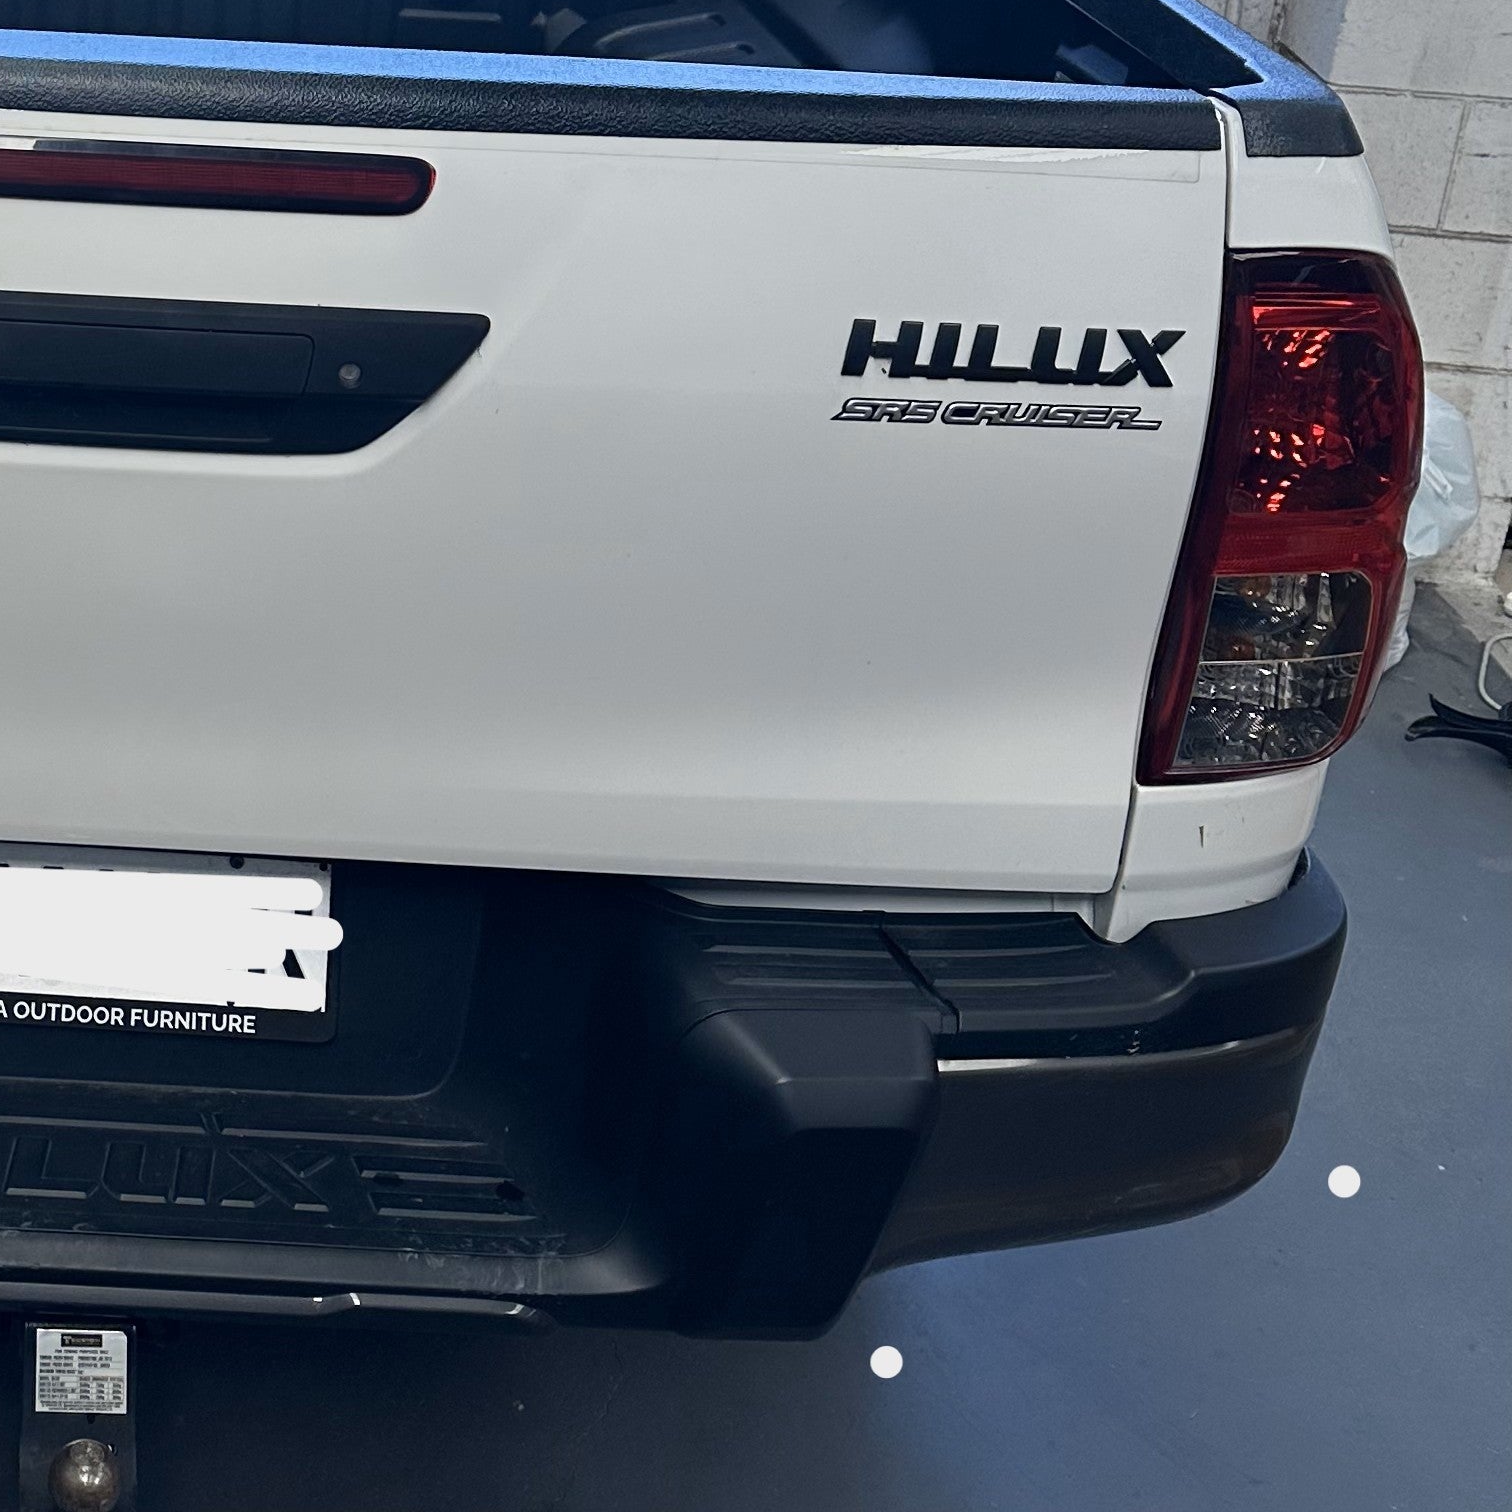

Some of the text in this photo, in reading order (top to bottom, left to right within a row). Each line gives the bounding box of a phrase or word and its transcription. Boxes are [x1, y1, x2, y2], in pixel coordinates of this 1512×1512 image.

[841, 318, 1187, 388] HILUX
[830, 397, 1163, 431] SR5 CRUISER
[13, 1000, 125, 1027] OUTDOOR
[130, 1007, 256, 1035] FURNITURE
